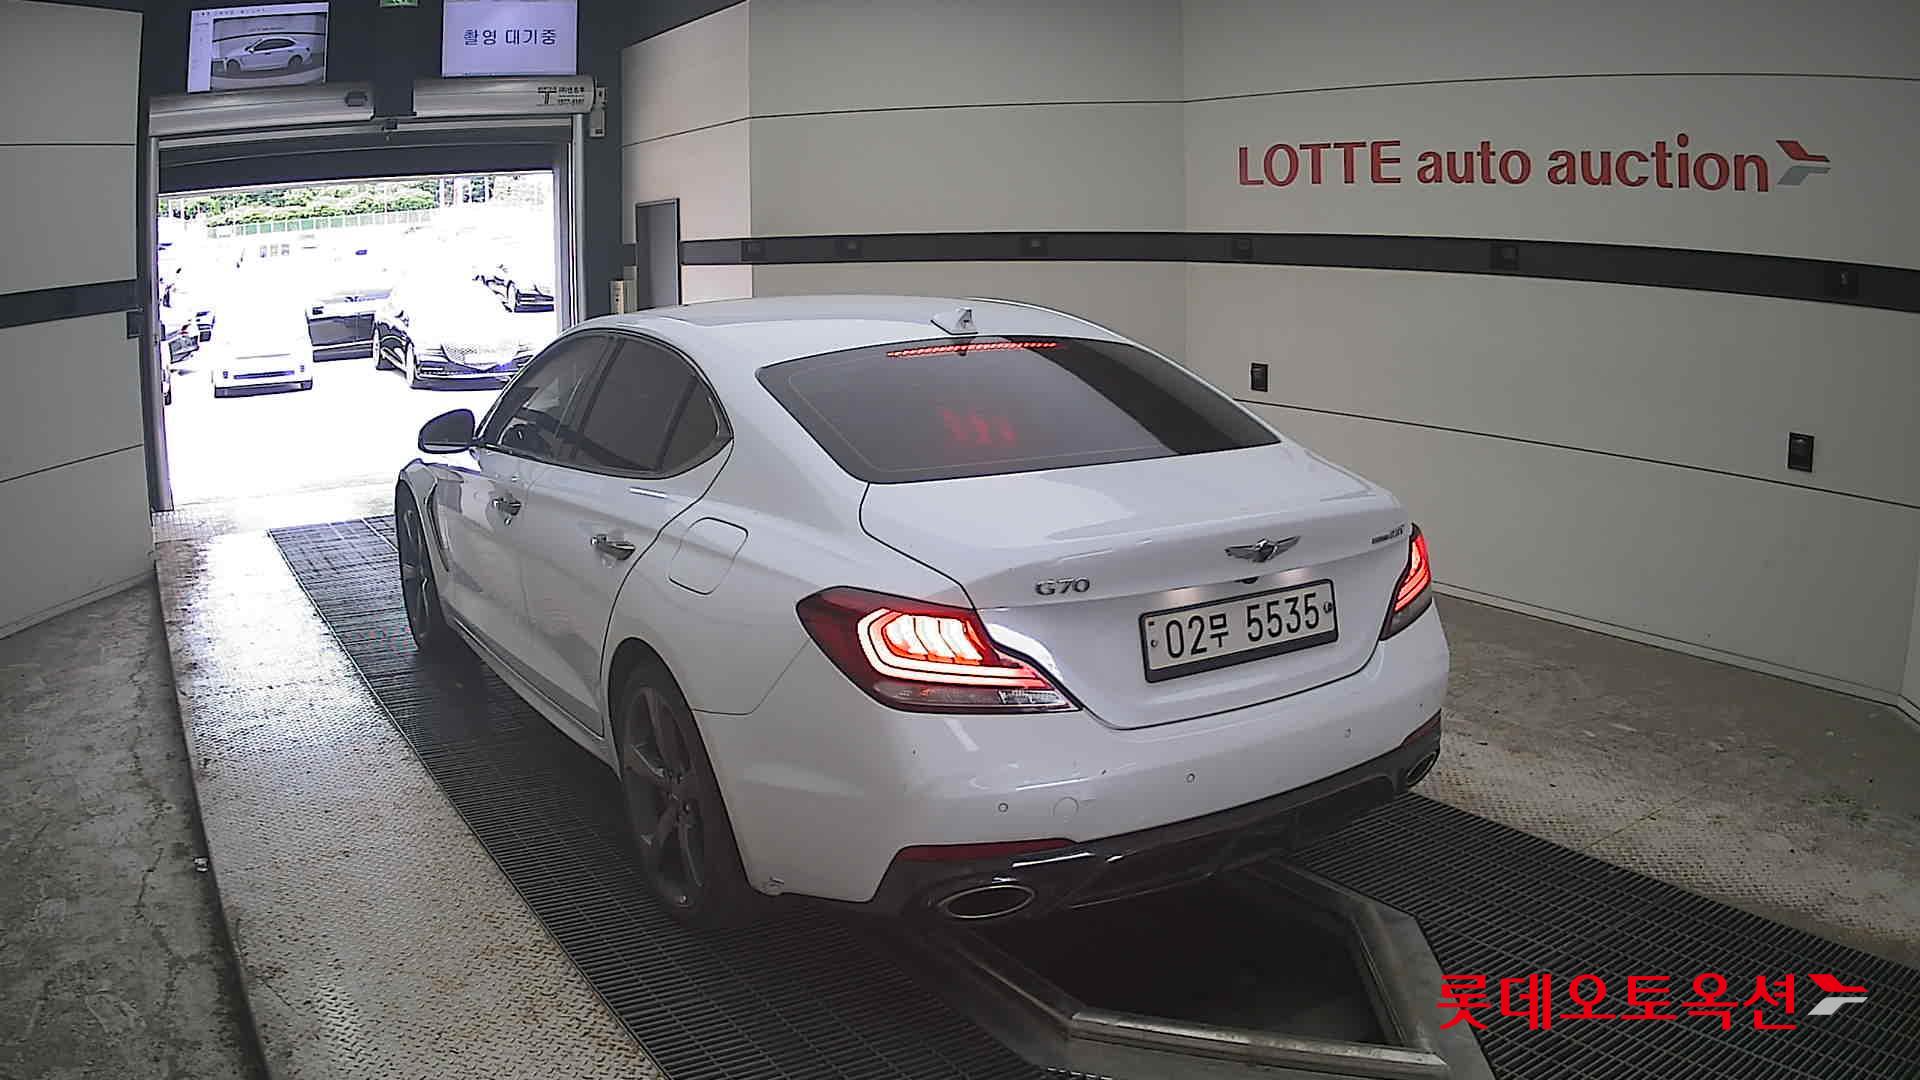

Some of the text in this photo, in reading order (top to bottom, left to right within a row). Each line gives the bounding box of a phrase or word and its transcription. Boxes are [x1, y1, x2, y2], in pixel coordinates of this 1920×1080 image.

[463, 28, 558, 46] 촬영 대기중
[1238, 132, 1770, 193] LOTTE auto auction
[1034, 576, 1091, 597] G70
[1164, 591, 1321, 660] 02무 5535
